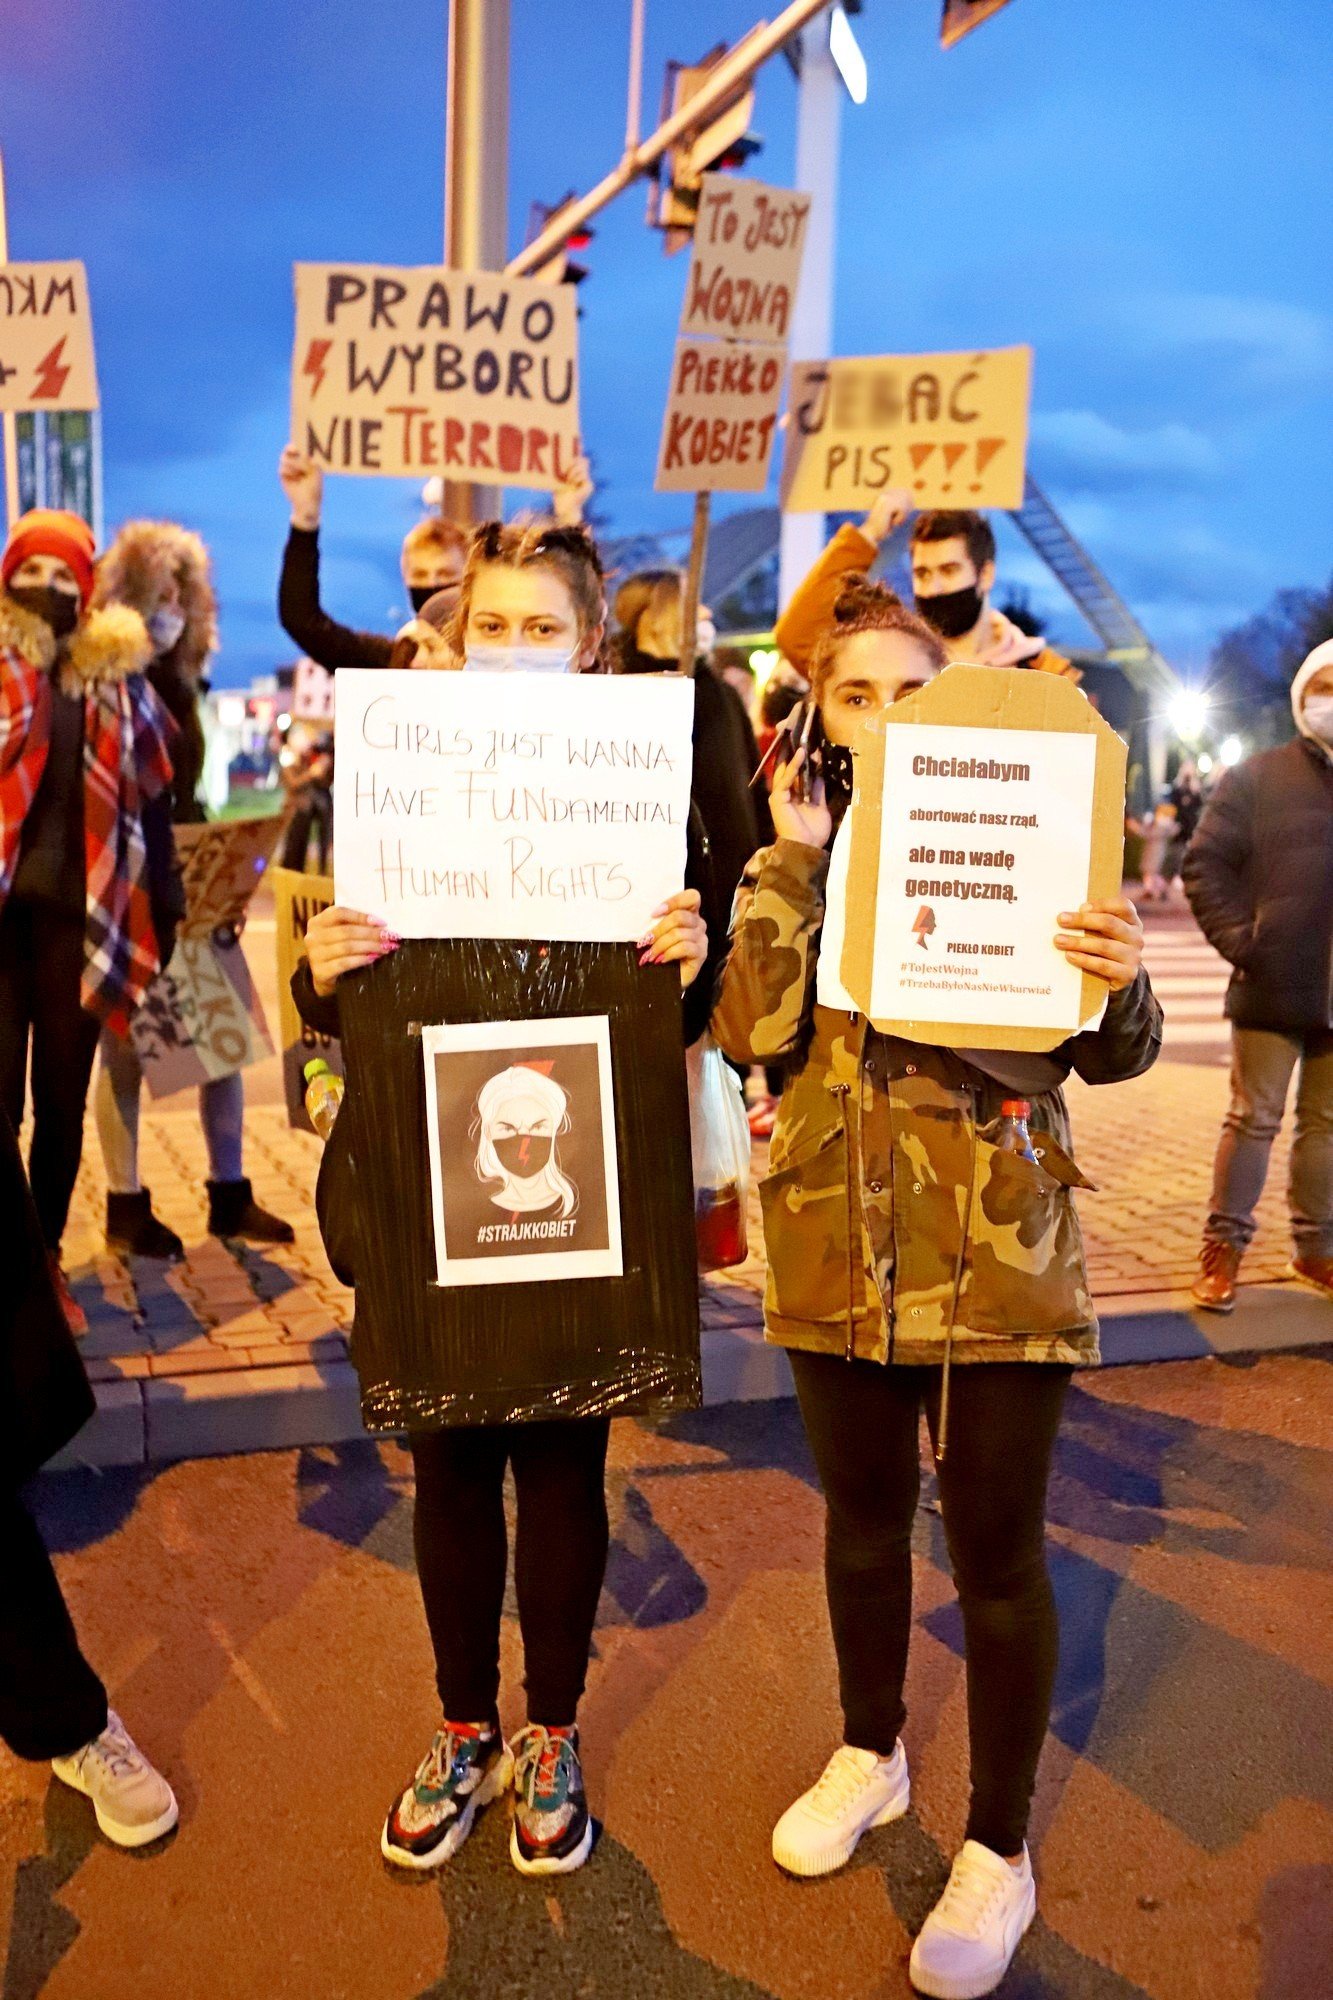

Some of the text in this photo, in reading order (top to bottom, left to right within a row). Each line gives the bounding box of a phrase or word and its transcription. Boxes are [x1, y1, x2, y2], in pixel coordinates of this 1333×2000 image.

[326, 273, 555, 343] PRAWO
[688, 260, 789, 337] WOJNA
[347, 339, 574, 405] WYBORU
[676, 349, 779, 396] PIEKŁO
[798, 352, 988, 436] JAĆ
[306, 405, 579, 484] NIE TERRORU
[663, 410, 777, 471] KOBIET
[362, 695, 474, 756] GIRLS
[567, 737, 676, 772] WANNA
[911, 754, 1031, 783] Chciałabym
[354, 769, 681, 825] HAVE FUNDAMENTAL
[909, 808, 1039, 829] abortować nasz rząd,
[374, 835, 633, 903] HUMAN RIGHTS
[908, 845, 1015, 871] ale ma wadę
[904, 878, 1018, 904] genetyczną.
[900, 961, 979, 977] #ToJestWojna
[946, 942, 1015, 957] PIEKŁO KOBIET
[899, 977, 1052, 996] #TrzebaByłoNasNieWkurwiać
[476, 1218, 577, 1244] #STRAJKKOBIET
